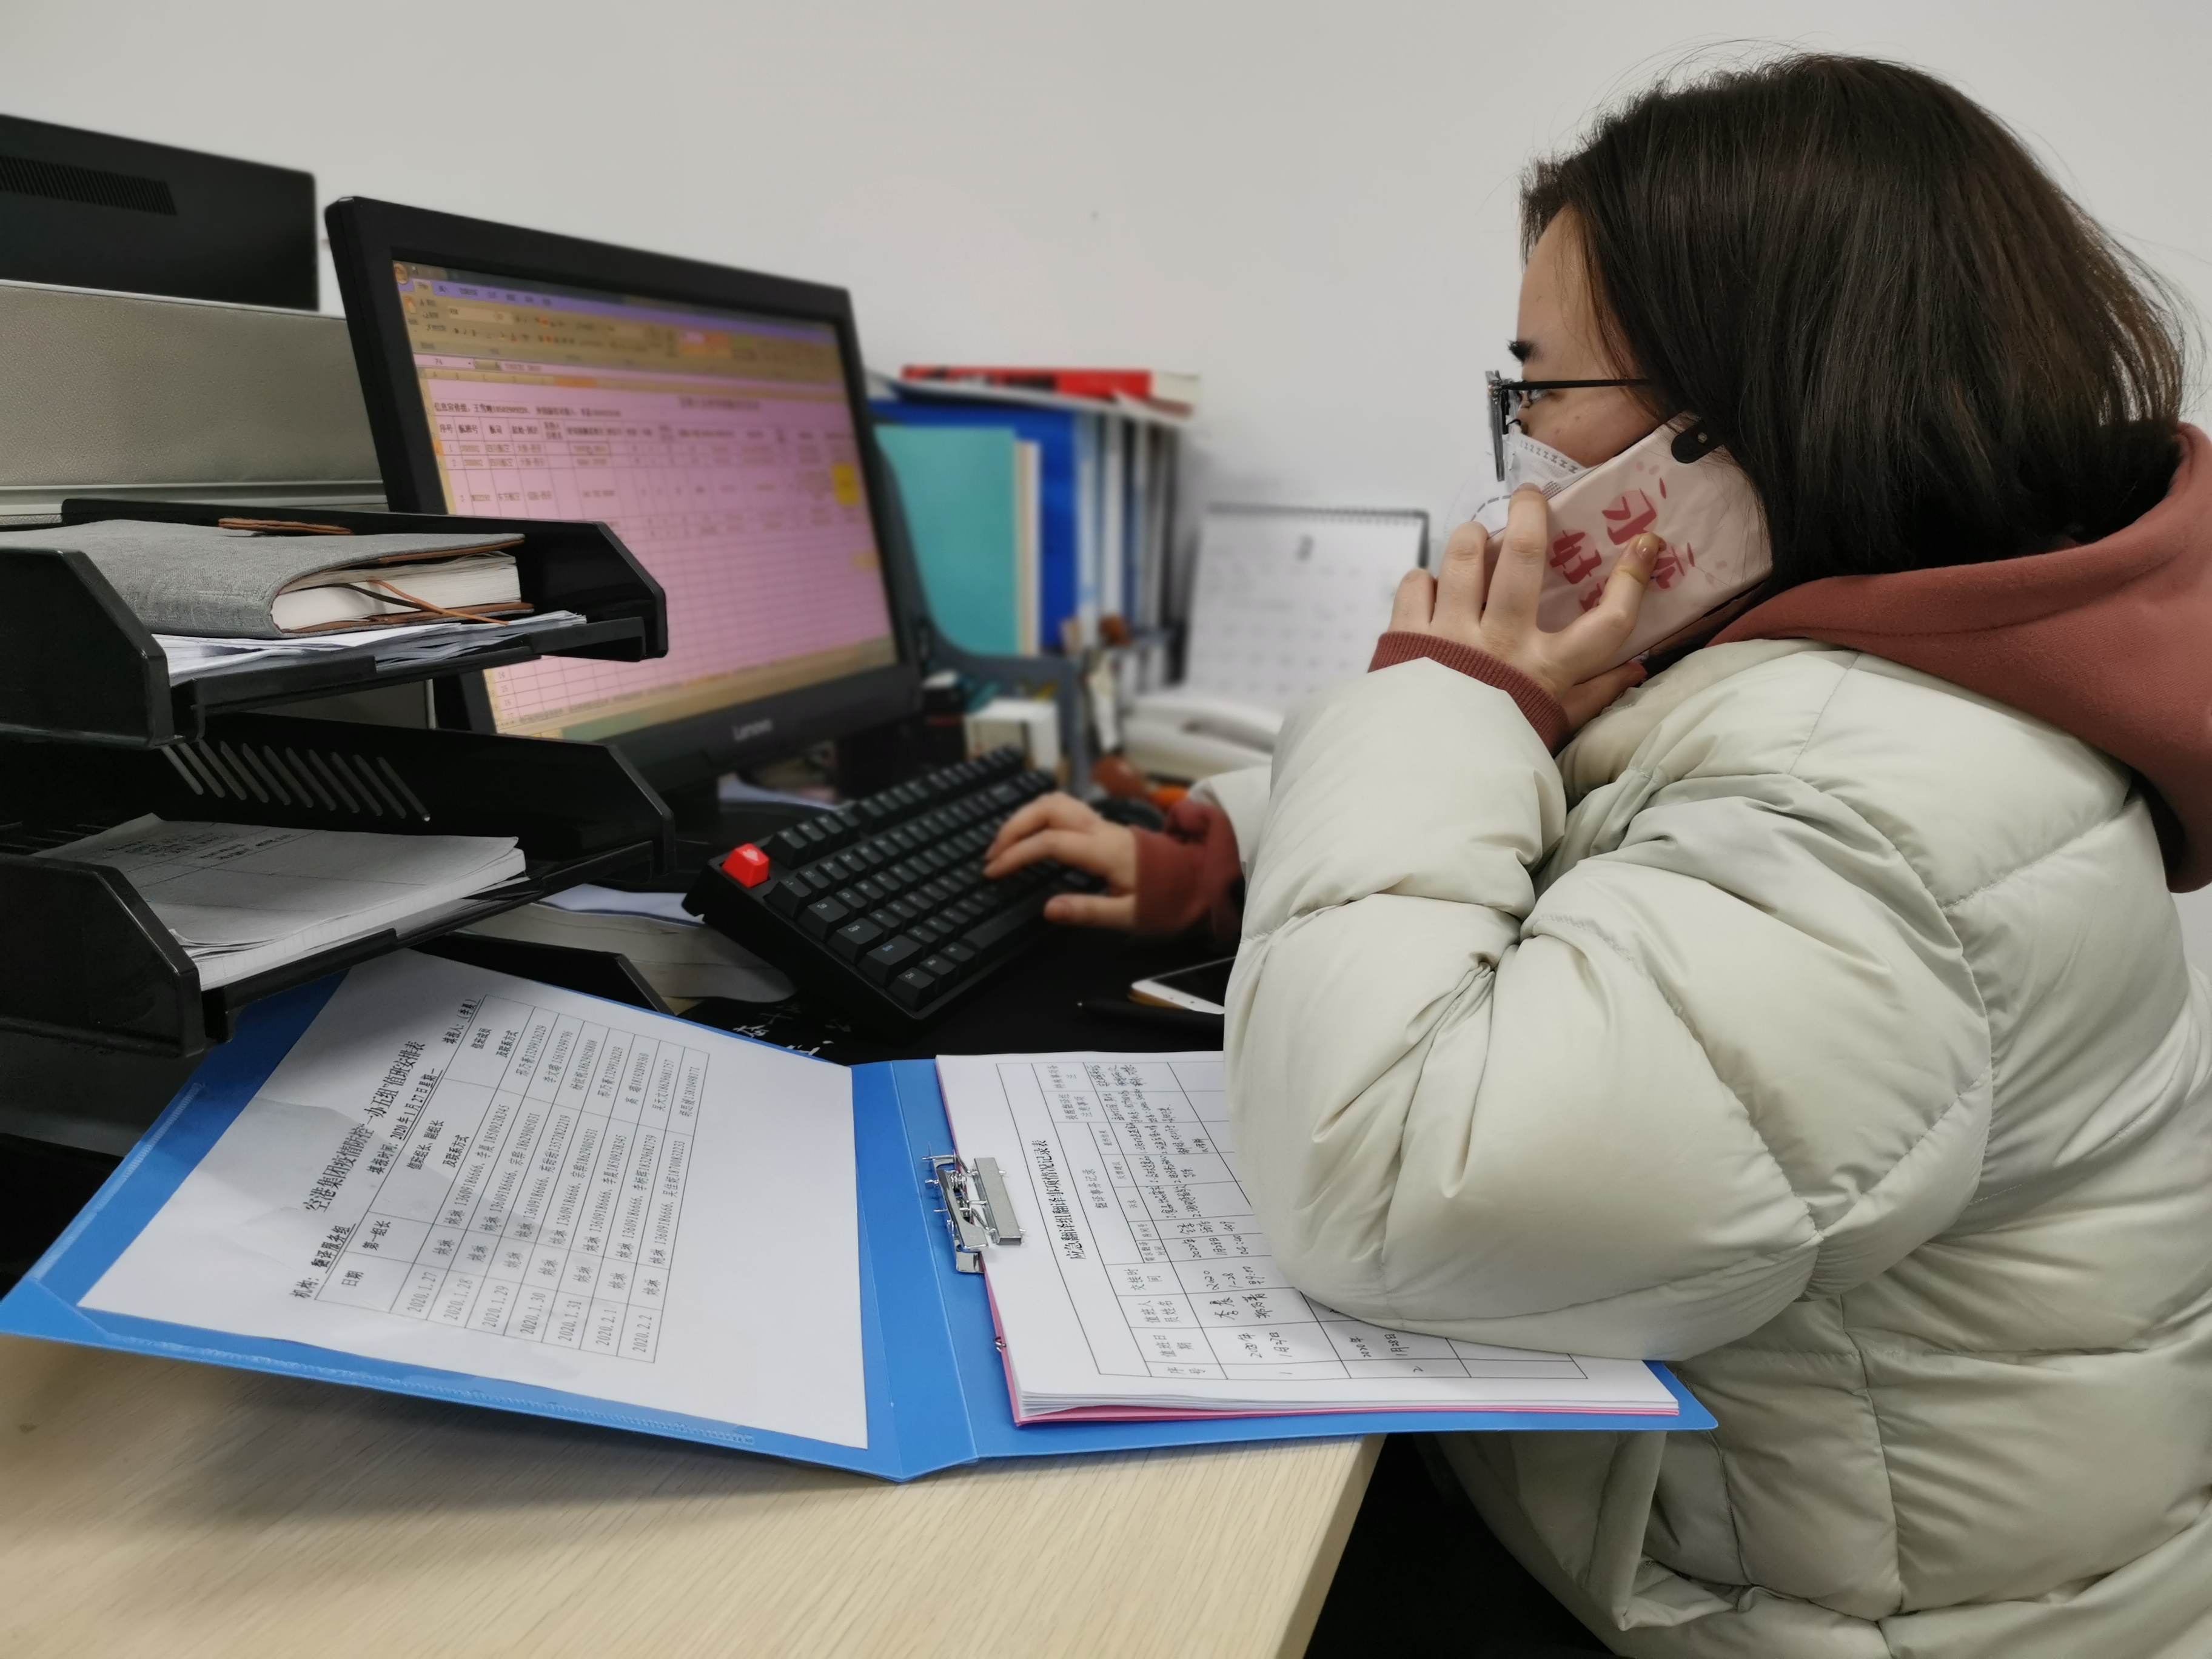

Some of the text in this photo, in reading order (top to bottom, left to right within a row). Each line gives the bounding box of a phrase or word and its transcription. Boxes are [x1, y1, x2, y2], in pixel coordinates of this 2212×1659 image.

[441, 1030, 519, 1168] 及联系方式 及联系方式
[340, 1270, 364, 1287] 日期
[361, 1220, 391, 1251] 第一组长
[1031, 1139, 1085, 1259] 应急翻译组翻译事项情况记录表
